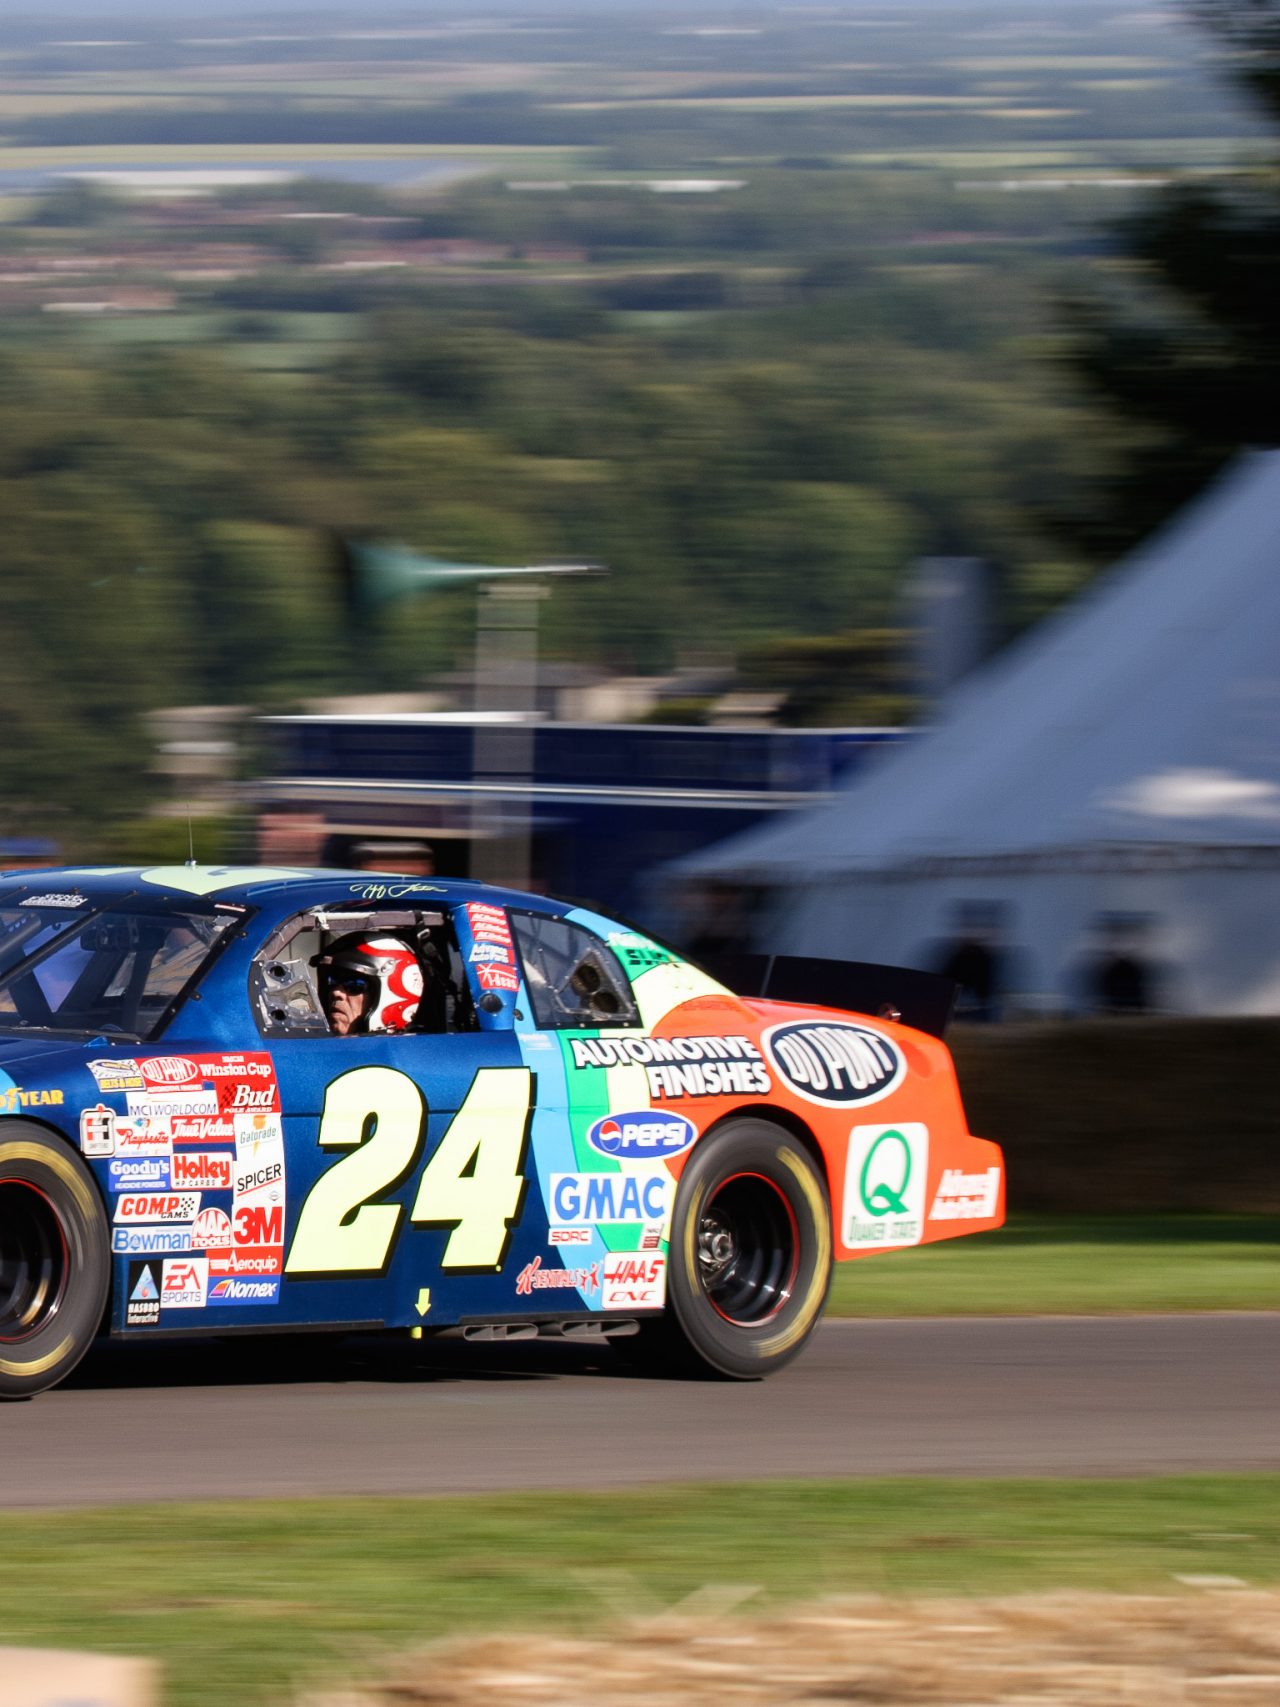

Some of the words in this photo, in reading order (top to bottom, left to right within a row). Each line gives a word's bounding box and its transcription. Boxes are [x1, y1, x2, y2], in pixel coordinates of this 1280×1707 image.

[570, 1035, 763, 1069] AUTOMOTIVE
[199, 1063, 247, 1077] Winston
[247, 1062, 272, 1078] Cup
[646, 1061, 772, 1100] FINISHES
[232, 1084, 276, 1107] Bud
[130, 1105, 152, 1116] MCI
[154, 1103, 216, 1115] WORLDCOM
[239, 1127, 277, 1145] Gatorade
[621, 1122, 687, 1148] PEPSI
[110, 1159, 170, 1180] Goody's
[173, 1155, 231, 1186] Holley
[237, 1163, 282, 1192] SPICER
[284, 1065, 533, 1274] 24
[860, 1129, 911, 1217] Q
[121, 1196, 180, 1217] COMP
[554, 1176, 665, 1221] GMAC
[161, 1211, 189, 1219] CAMS
[195, 1210, 231, 1237] MAC
[234, 1206, 283, 1245] 3M
[113, 1229, 191, 1251] Bowman
[192, 1236, 231, 1248] TOOLS
[224, 1250, 278, 1273] Aeroquip
[604, 1259, 665, 1285] HAAS
[164, 1264, 201, 1290] EA
[161, 1291, 202, 1304] SPORTS
[226, 1280, 275, 1299] Nomex
[610, 1290, 657, 1302] CNC
[128, 1302, 160, 1314] HASBRO
